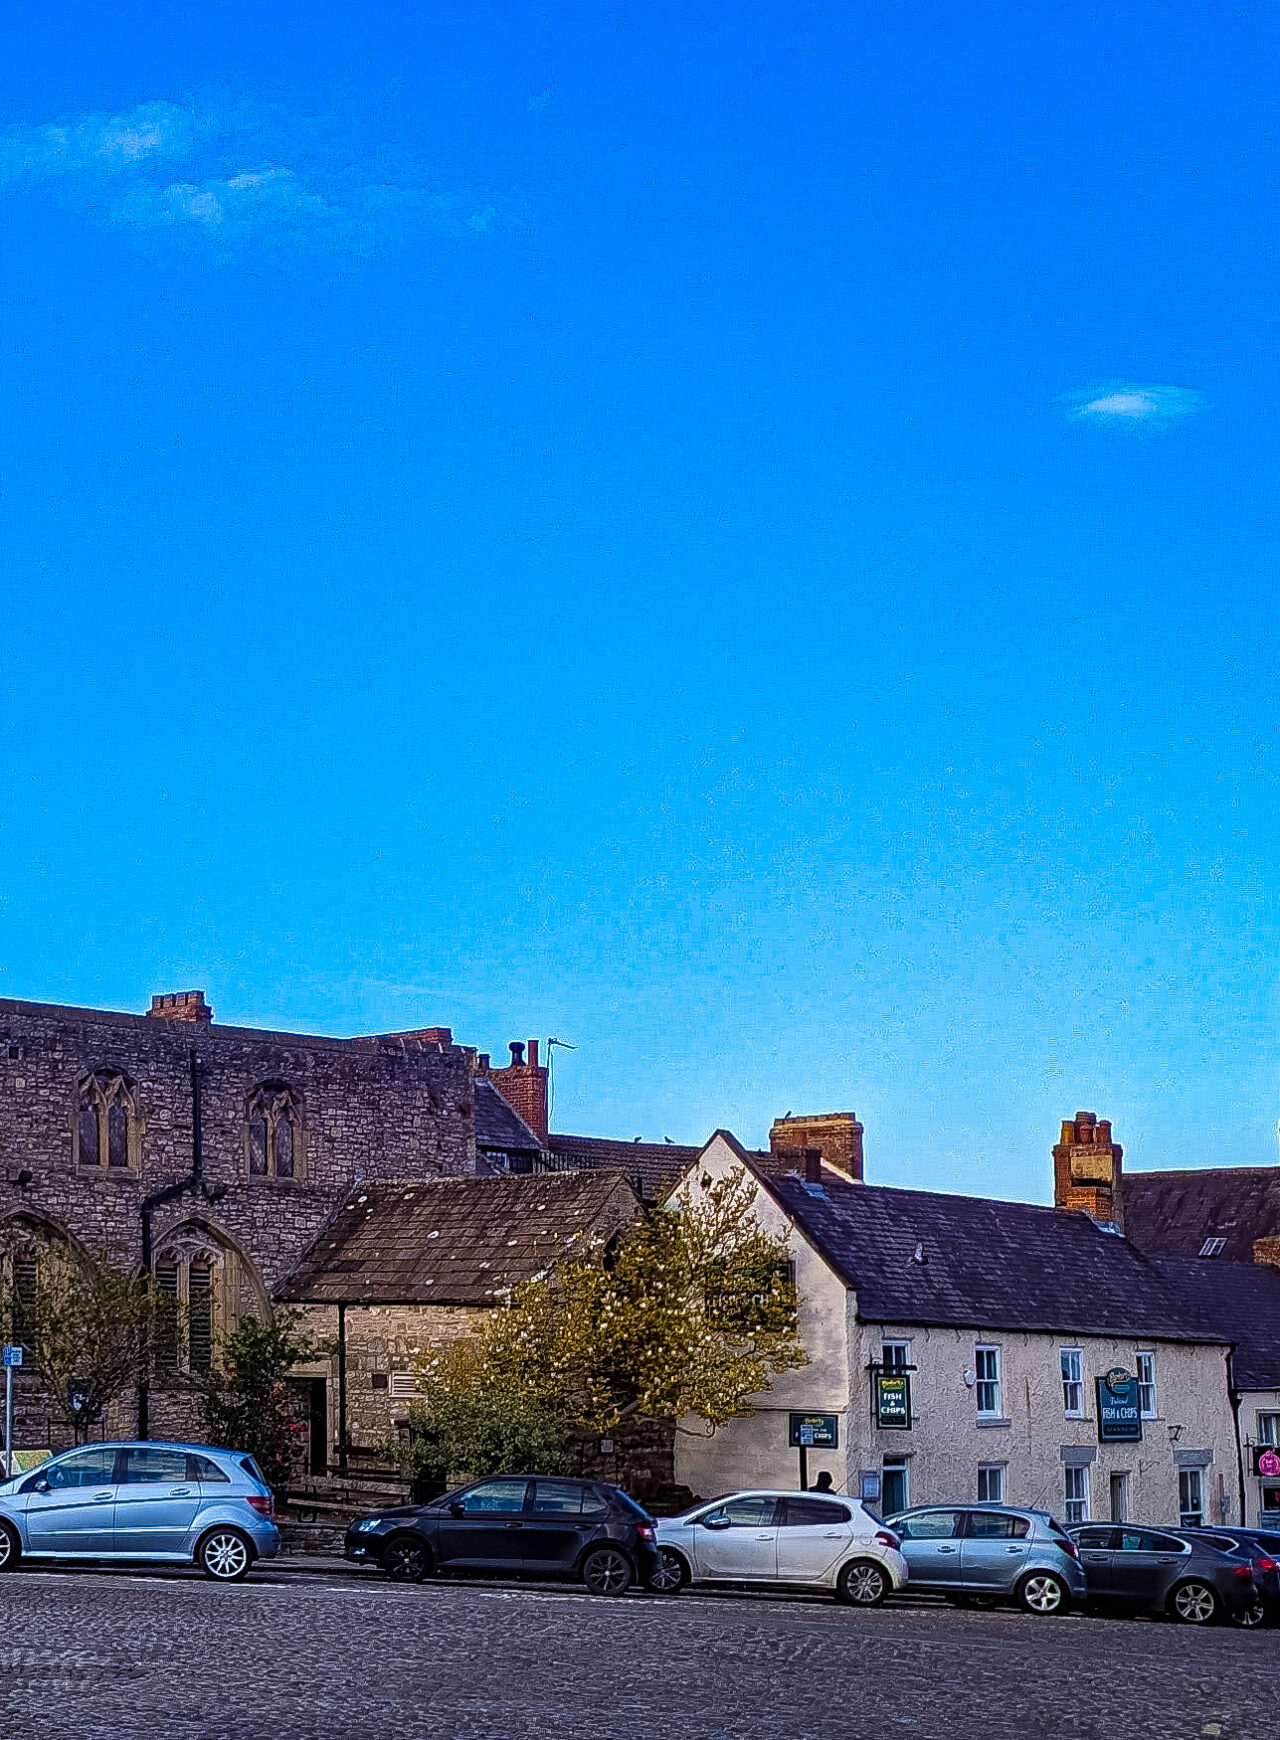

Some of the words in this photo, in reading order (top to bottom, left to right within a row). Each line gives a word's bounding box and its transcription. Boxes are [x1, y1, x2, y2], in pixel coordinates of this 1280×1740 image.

[883, 1393, 902, 1401] FISH
[880, 1406, 906, 1415] CHIPS
[1102, 1407, 1115, 1419] FISH
[1120, 1407, 1138, 1419] CHIPS
